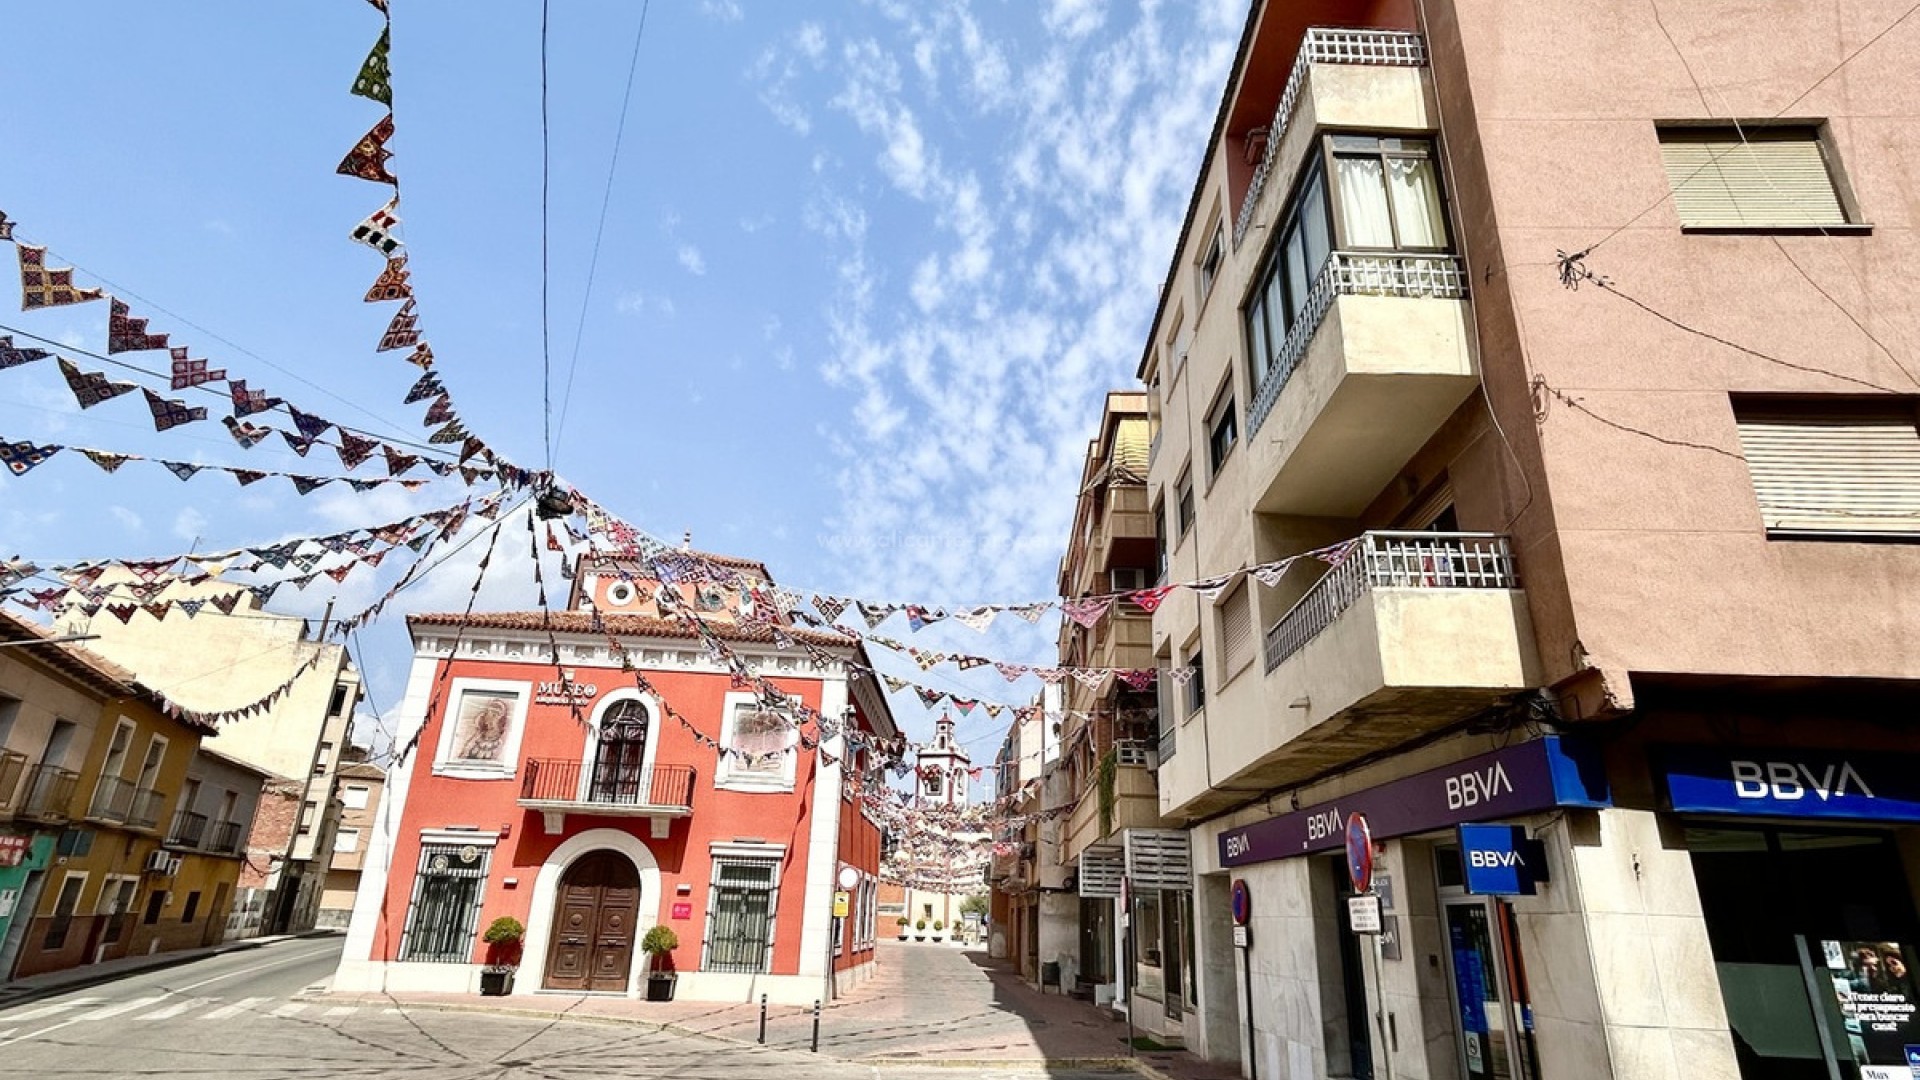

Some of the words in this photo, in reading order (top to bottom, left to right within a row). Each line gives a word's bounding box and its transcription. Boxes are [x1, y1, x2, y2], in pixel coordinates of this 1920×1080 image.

[537, 681, 598, 698] MUSEO
[1445, 761, 1513, 810] BBVA
[1731, 760, 1875, 802] BBVA
[1307, 806, 1344, 841] BBVA
[1226, 832, 1251, 858] BBVA
[1470, 849, 1526, 868] BBVA
